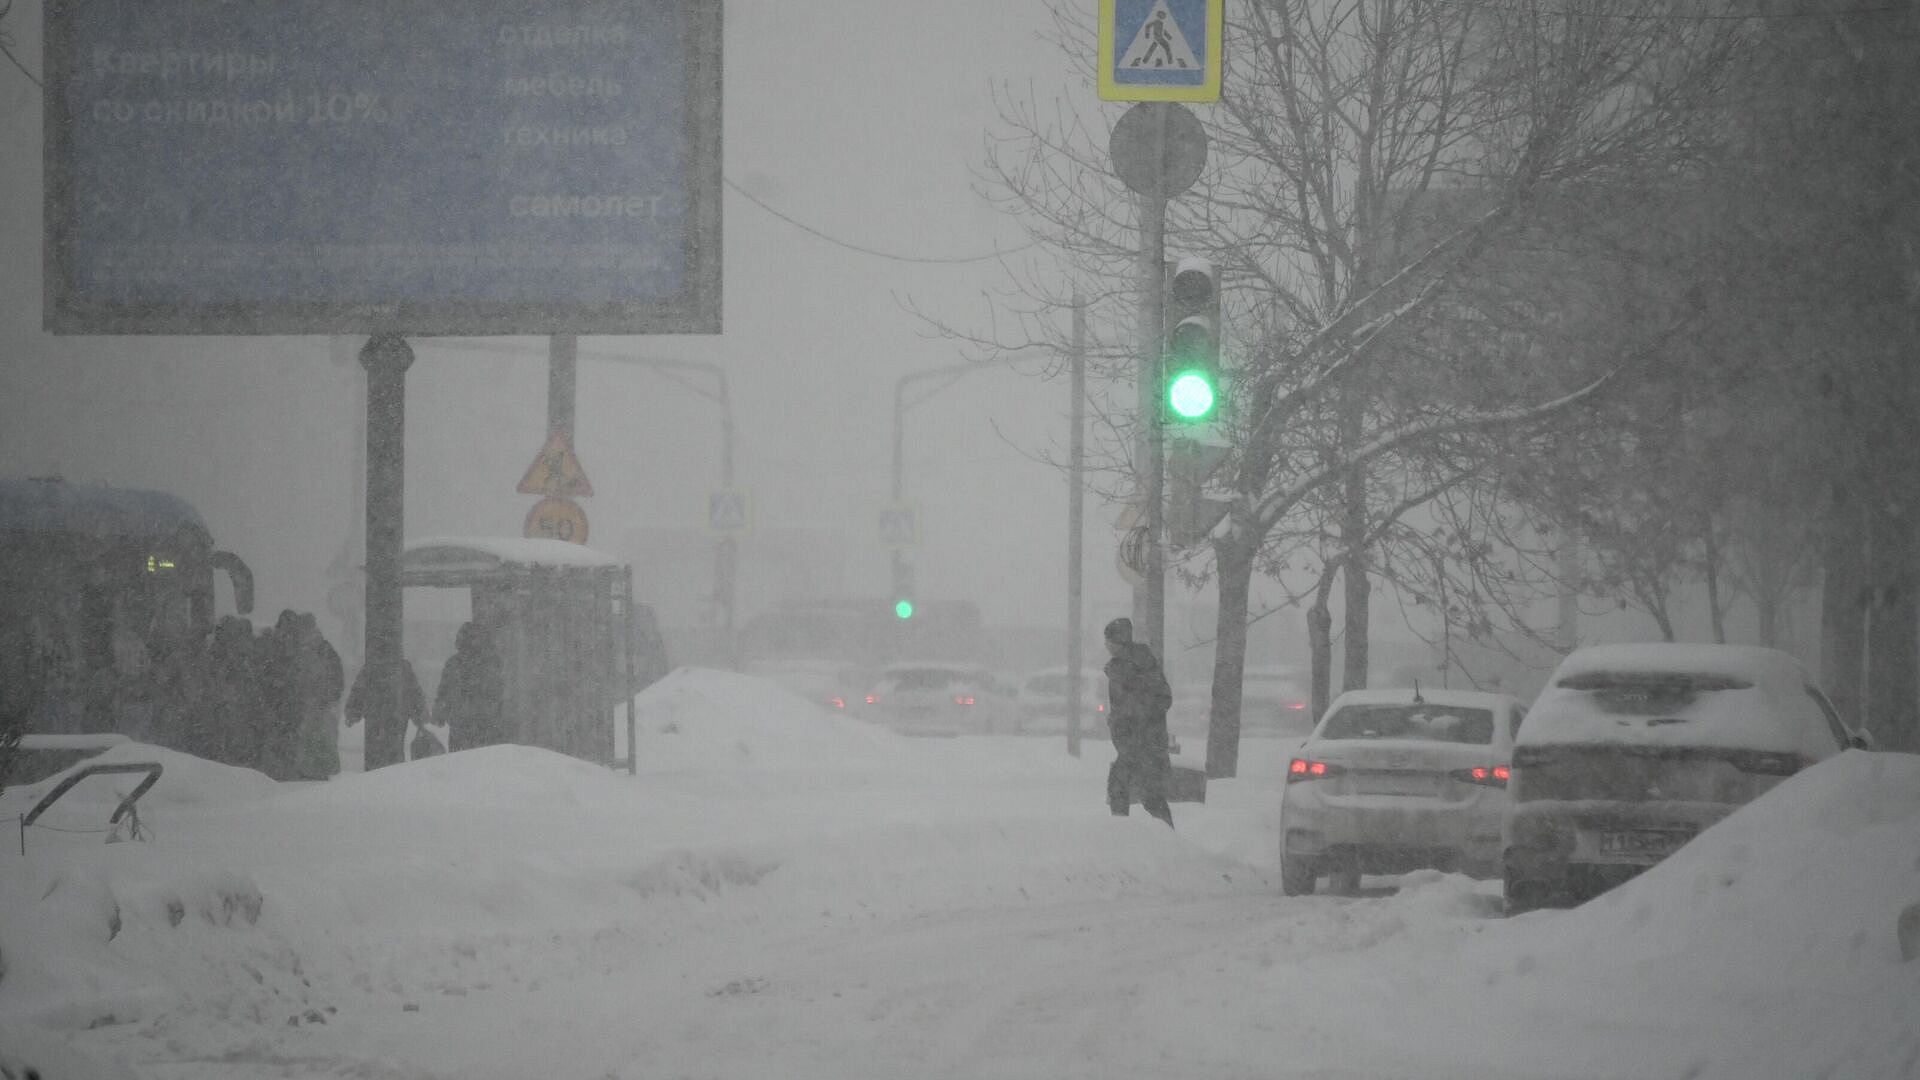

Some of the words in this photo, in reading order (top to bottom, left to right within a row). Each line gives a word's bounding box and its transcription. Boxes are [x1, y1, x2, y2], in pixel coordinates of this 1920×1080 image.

[92, 46, 276, 79] Квартиры
[504, 70, 622, 97] мебель
[93, 100, 134, 122] со
[146, 93, 295, 126] скидкой
[307, 91, 389, 124] 10%
[502, 124, 628, 147] техника
[509, 193, 661, 219] самолет
[539, 518, 575, 542] 50
